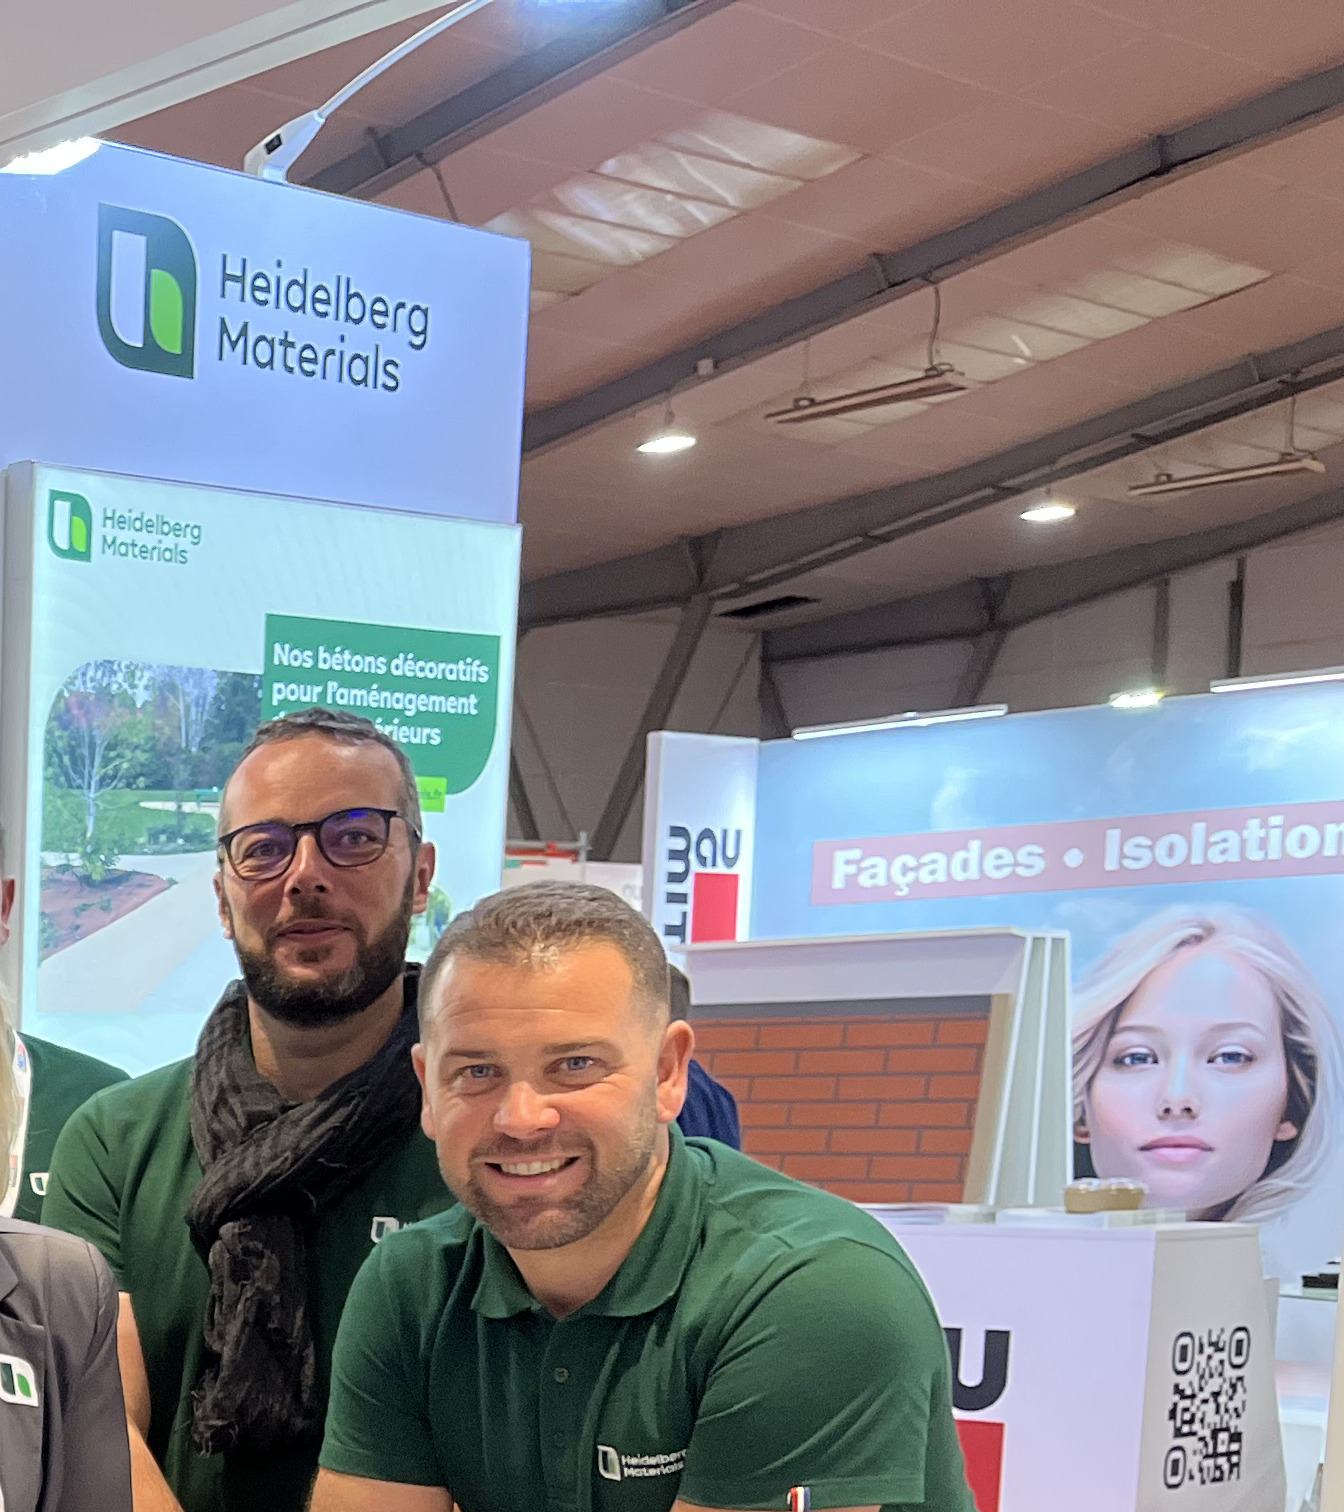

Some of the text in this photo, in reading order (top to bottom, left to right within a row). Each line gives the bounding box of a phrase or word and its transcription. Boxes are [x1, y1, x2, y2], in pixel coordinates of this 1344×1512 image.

[220, 253, 430, 350] Heidelberg
[218, 316, 400, 392] Materials
[102, 507, 202, 545] Heidelberg
[101, 534, 189, 565] Materials
[273, 642, 490, 683] Nos bétons décoratifs
[271, 680, 479, 716] pour l'aménagement
[831, 815, 1344, 896] Façades Isolation
[621, 1449, 687, 1466] Heidelber
